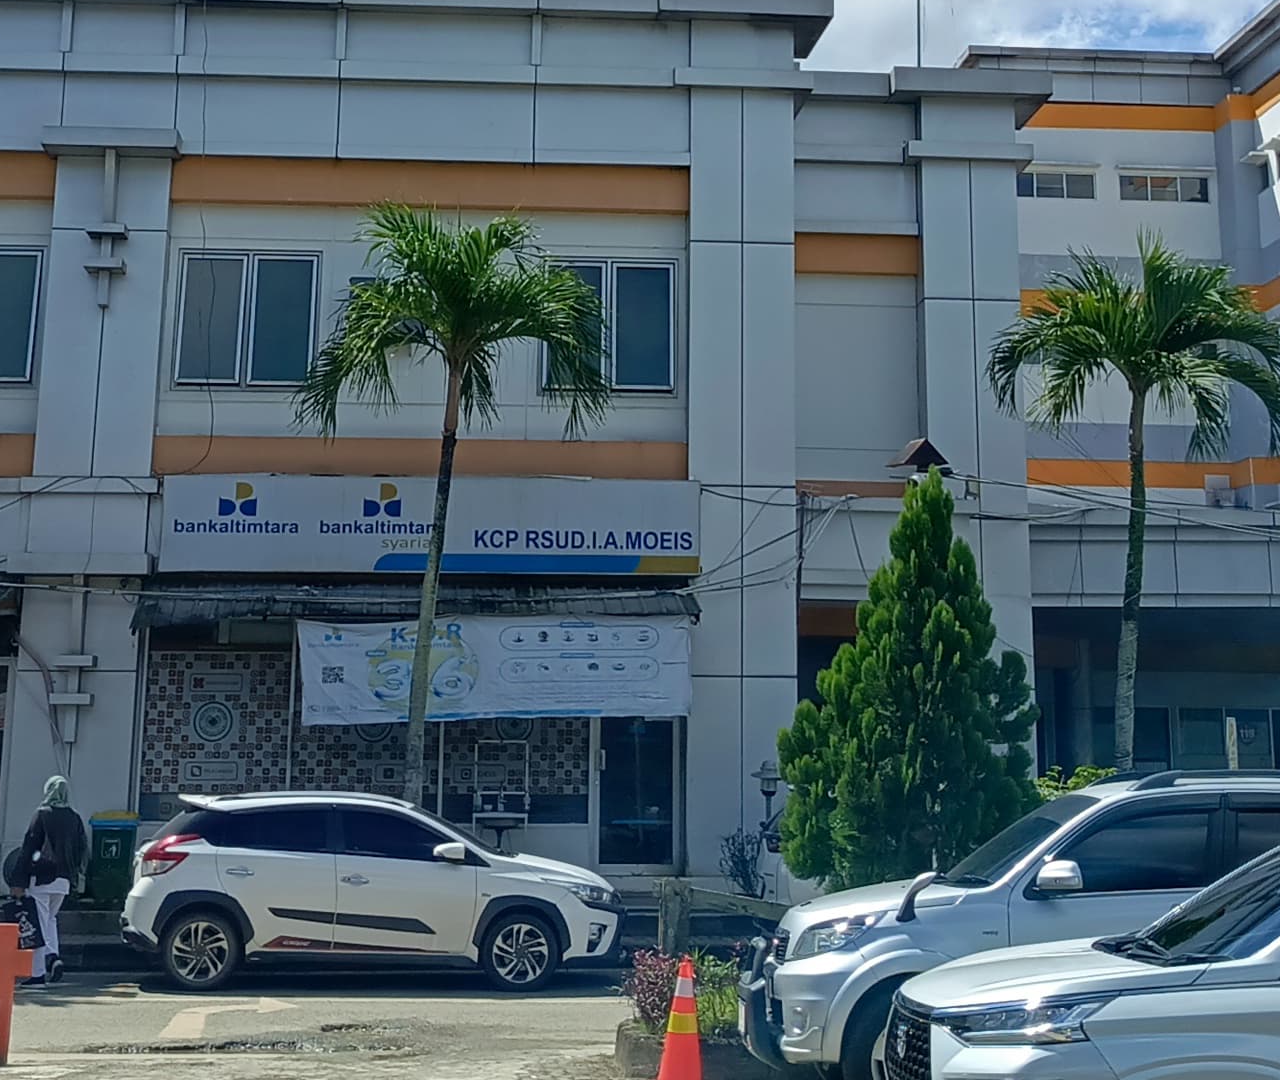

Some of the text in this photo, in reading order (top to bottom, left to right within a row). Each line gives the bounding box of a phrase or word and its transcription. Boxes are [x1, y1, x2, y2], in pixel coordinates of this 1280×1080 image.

[173, 518, 299, 534] bankaltimtara
[319, 519, 435, 535] bankaltimtar
[473, 529, 693, 551] KCP RSUD.I.A.MOEIS
